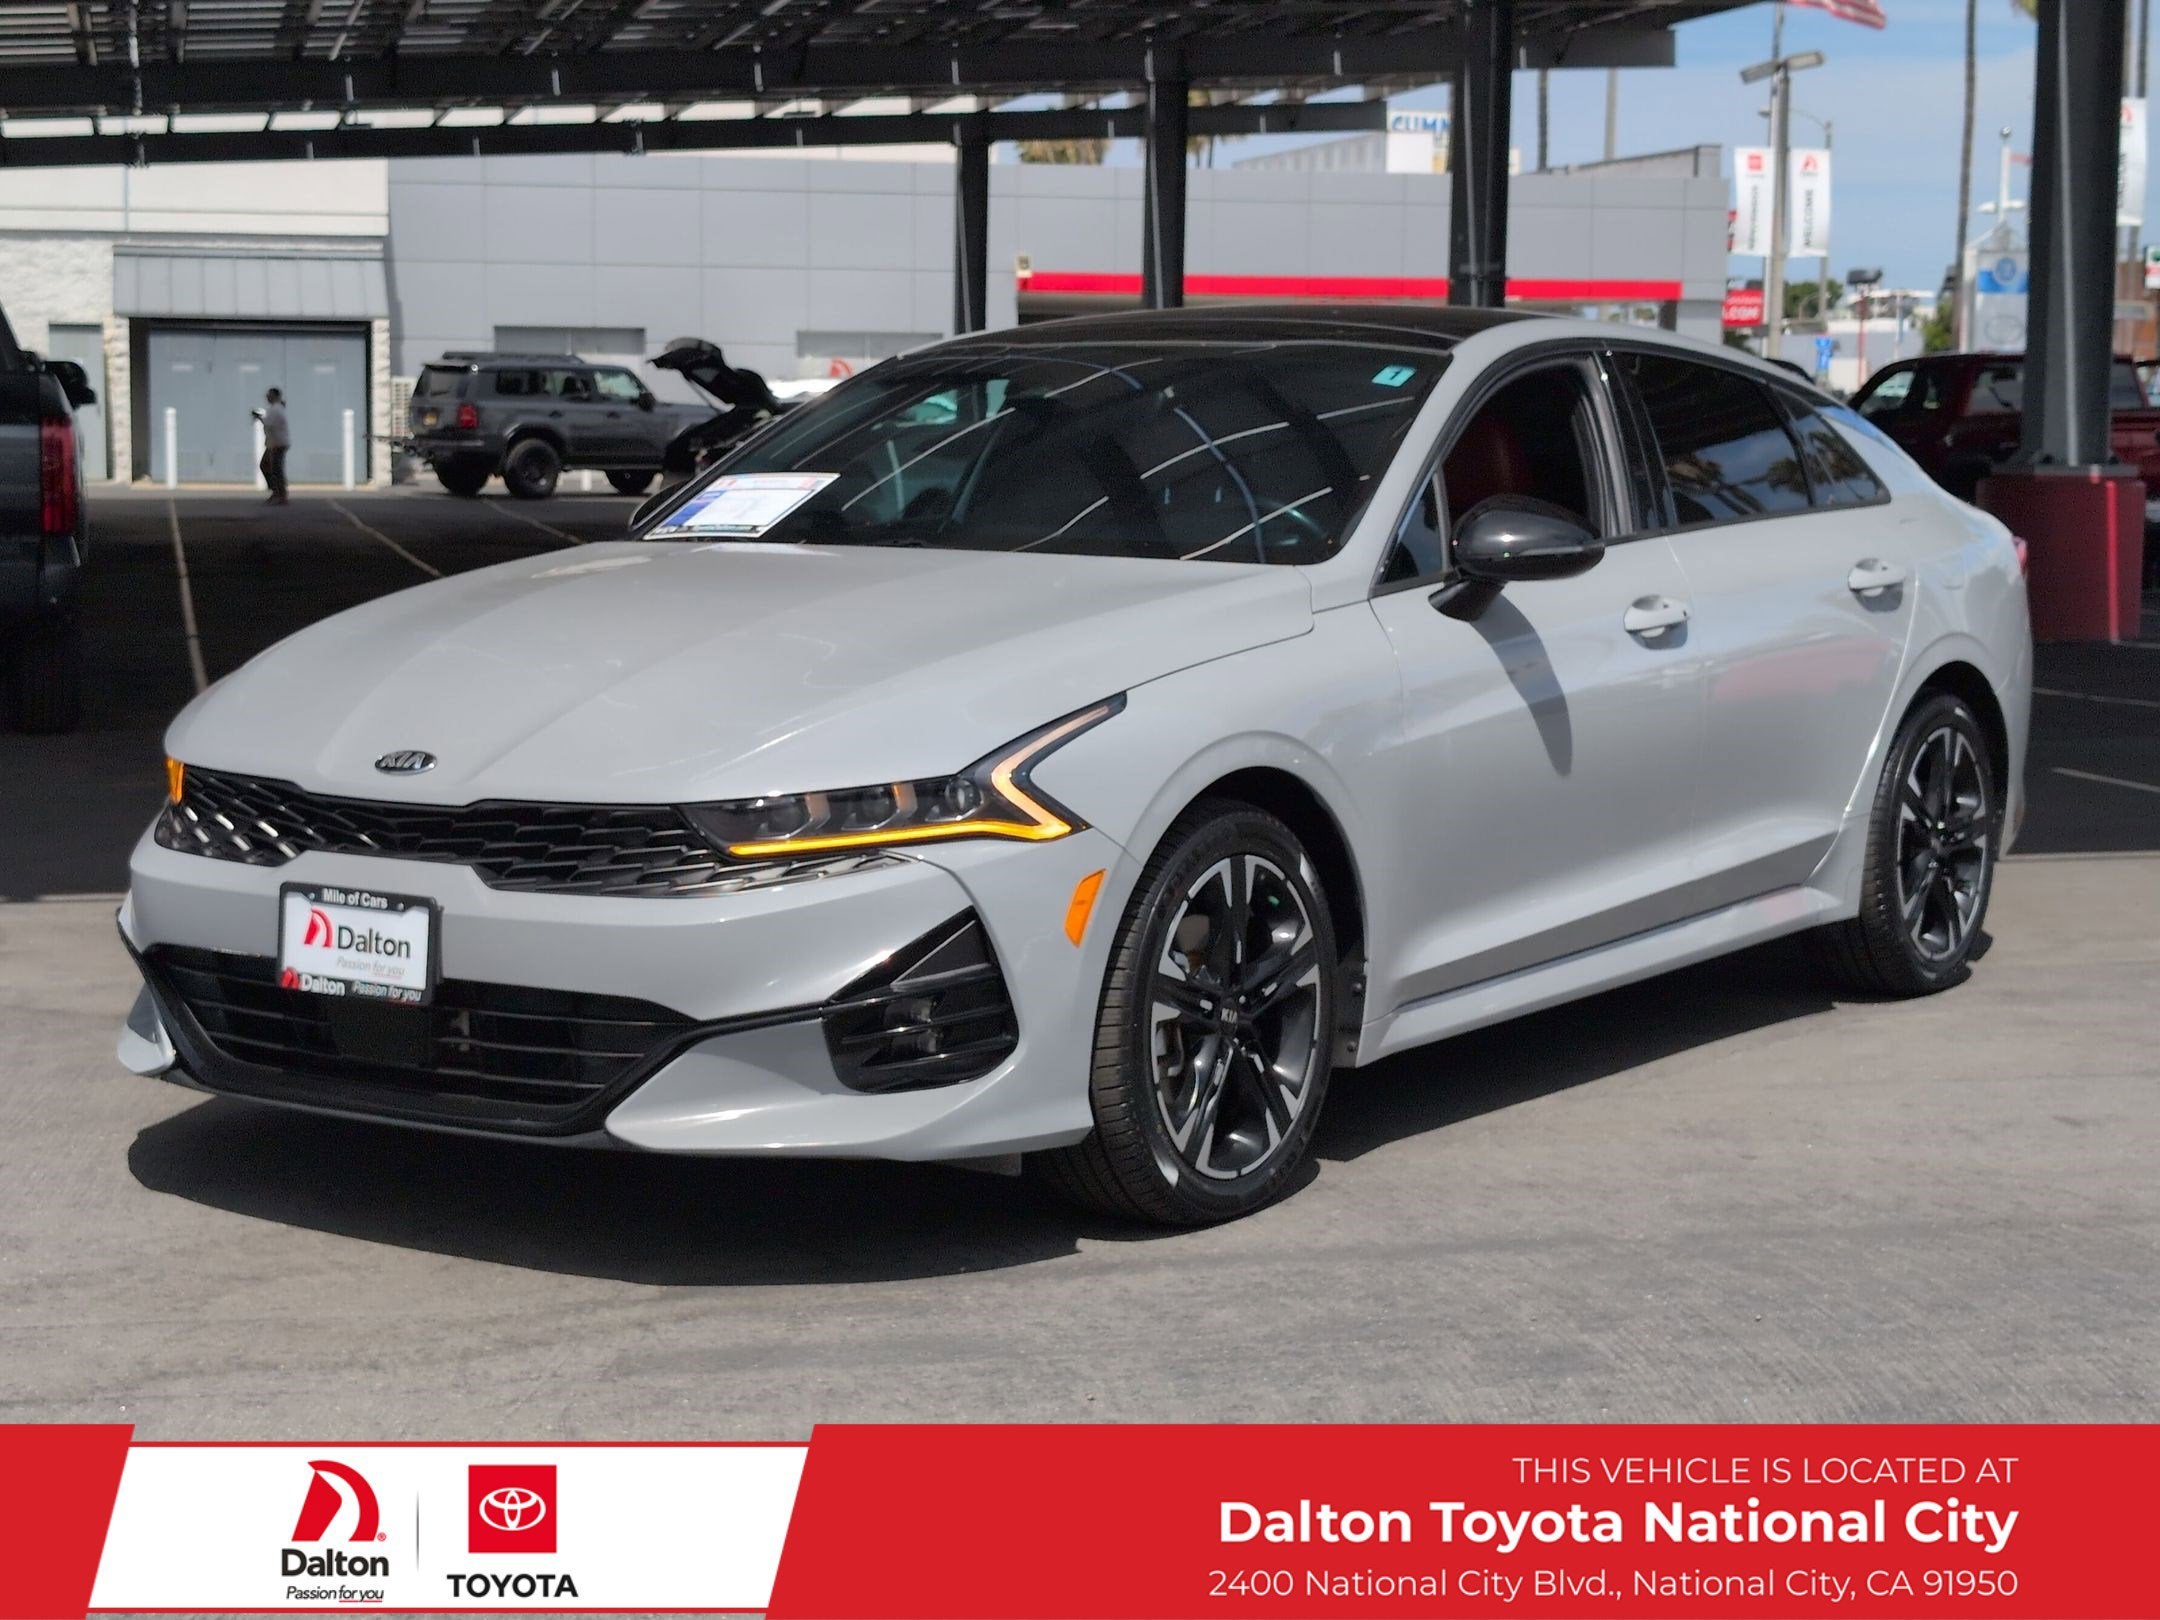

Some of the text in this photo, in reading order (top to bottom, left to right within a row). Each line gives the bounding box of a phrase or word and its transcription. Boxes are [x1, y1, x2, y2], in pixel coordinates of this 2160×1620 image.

[380, 750, 427, 769] KIA
[323, 888, 389, 909] Mile of Cars
[337, 925, 411, 959] Dalton
[336, 957, 406, 978] Passion for you
[300, 974, 422, 1003] Dalton Passion for you
[1221, 1008, 1238, 1025] KIA
